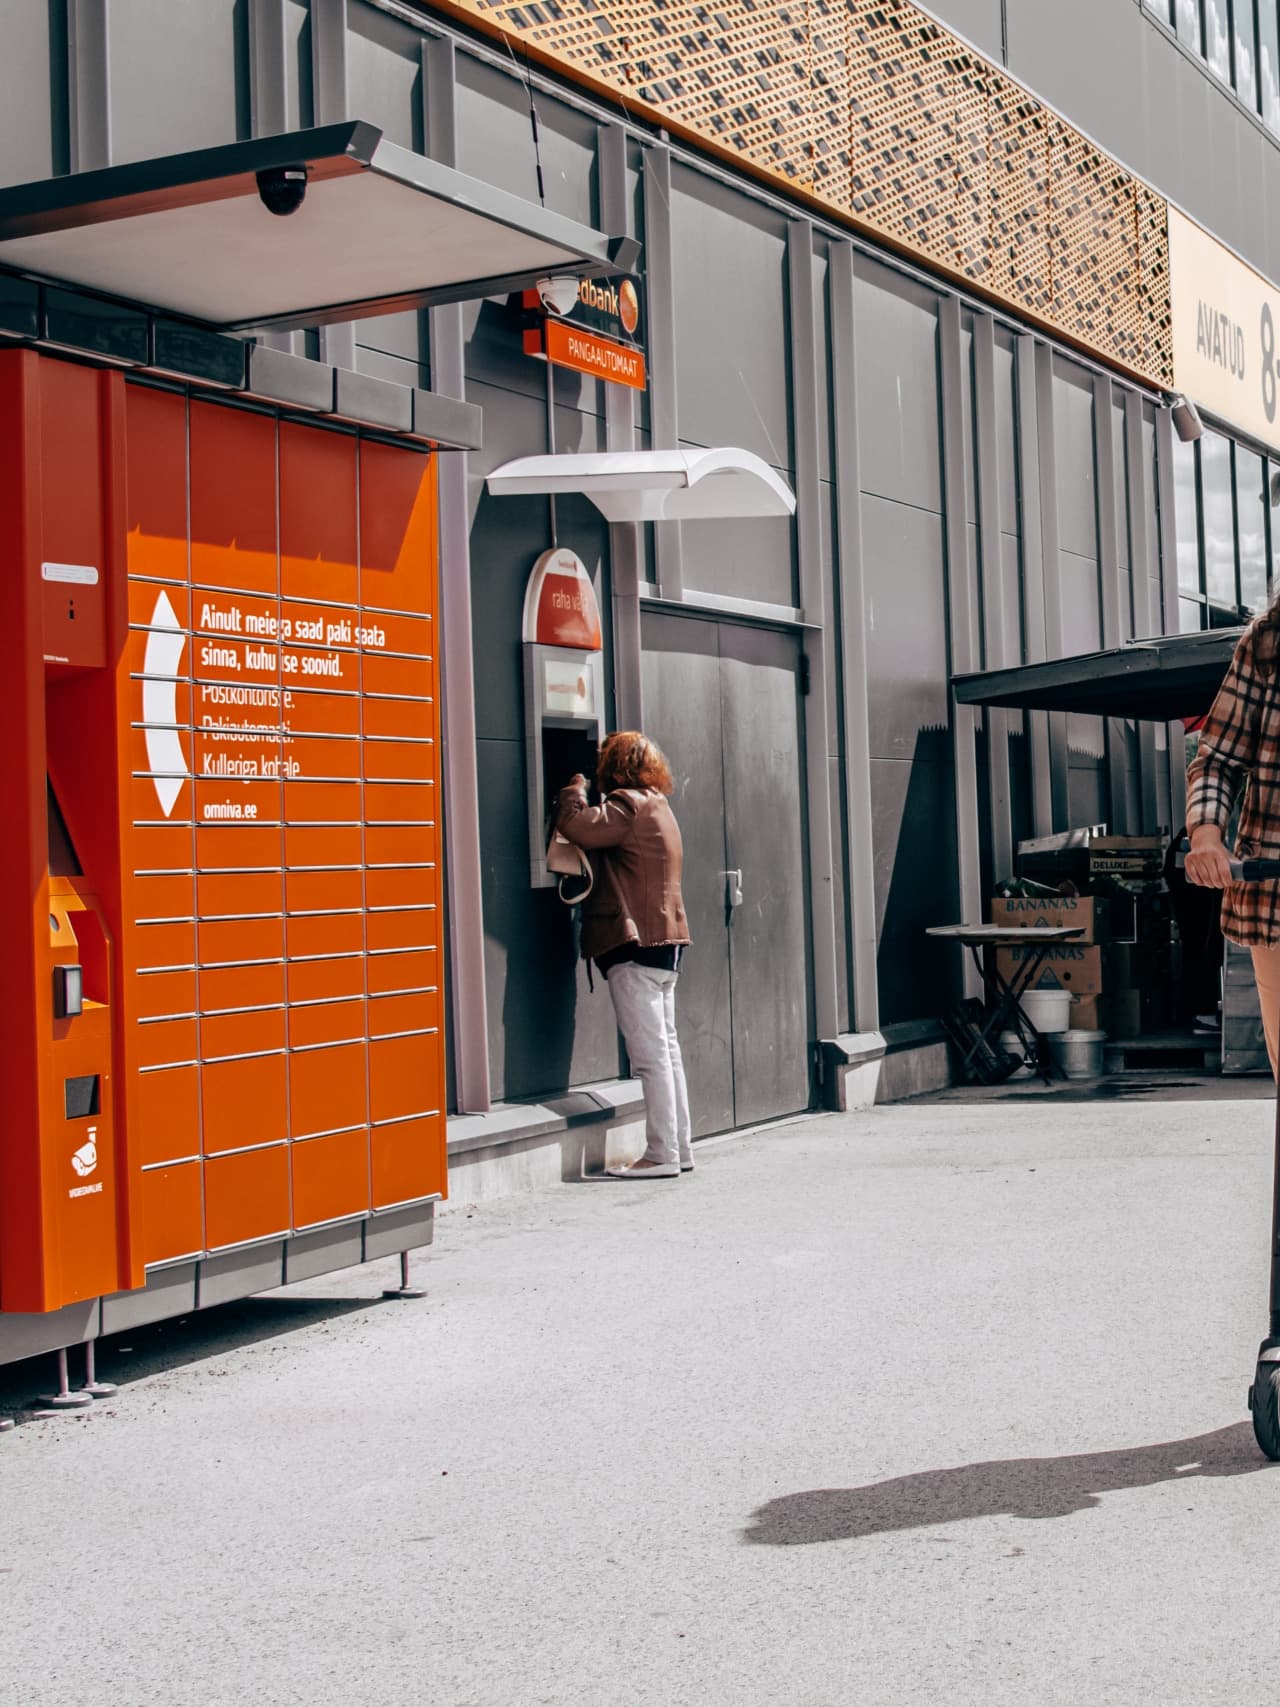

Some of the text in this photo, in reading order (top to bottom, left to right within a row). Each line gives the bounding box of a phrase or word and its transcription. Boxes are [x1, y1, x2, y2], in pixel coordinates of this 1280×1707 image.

[1196, 298, 1245, 381] AVATUD
[568, 337, 638, 378] PANGAAUTOMAAT
[552, 588, 571, 610] raha
[200, 603, 242, 632] Ainult
[295, 616, 324, 640] saad
[327, 620, 352, 645] paki
[355, 624, 386, 647] saata
[201, 641, 241, 671] sinna,
[245, 645, 277, 671] kuhu
[301, 653, 344, 677] soovid.
[202, 684, 296, 708] Postkontorise.
[203, 753, 258, 784] Kulleriga
[203, 799, 258, 819] omniva.ee
[1006, 899, 1078, 912] BANANAS
[1012, 947, 1085, 961] BNANAS
